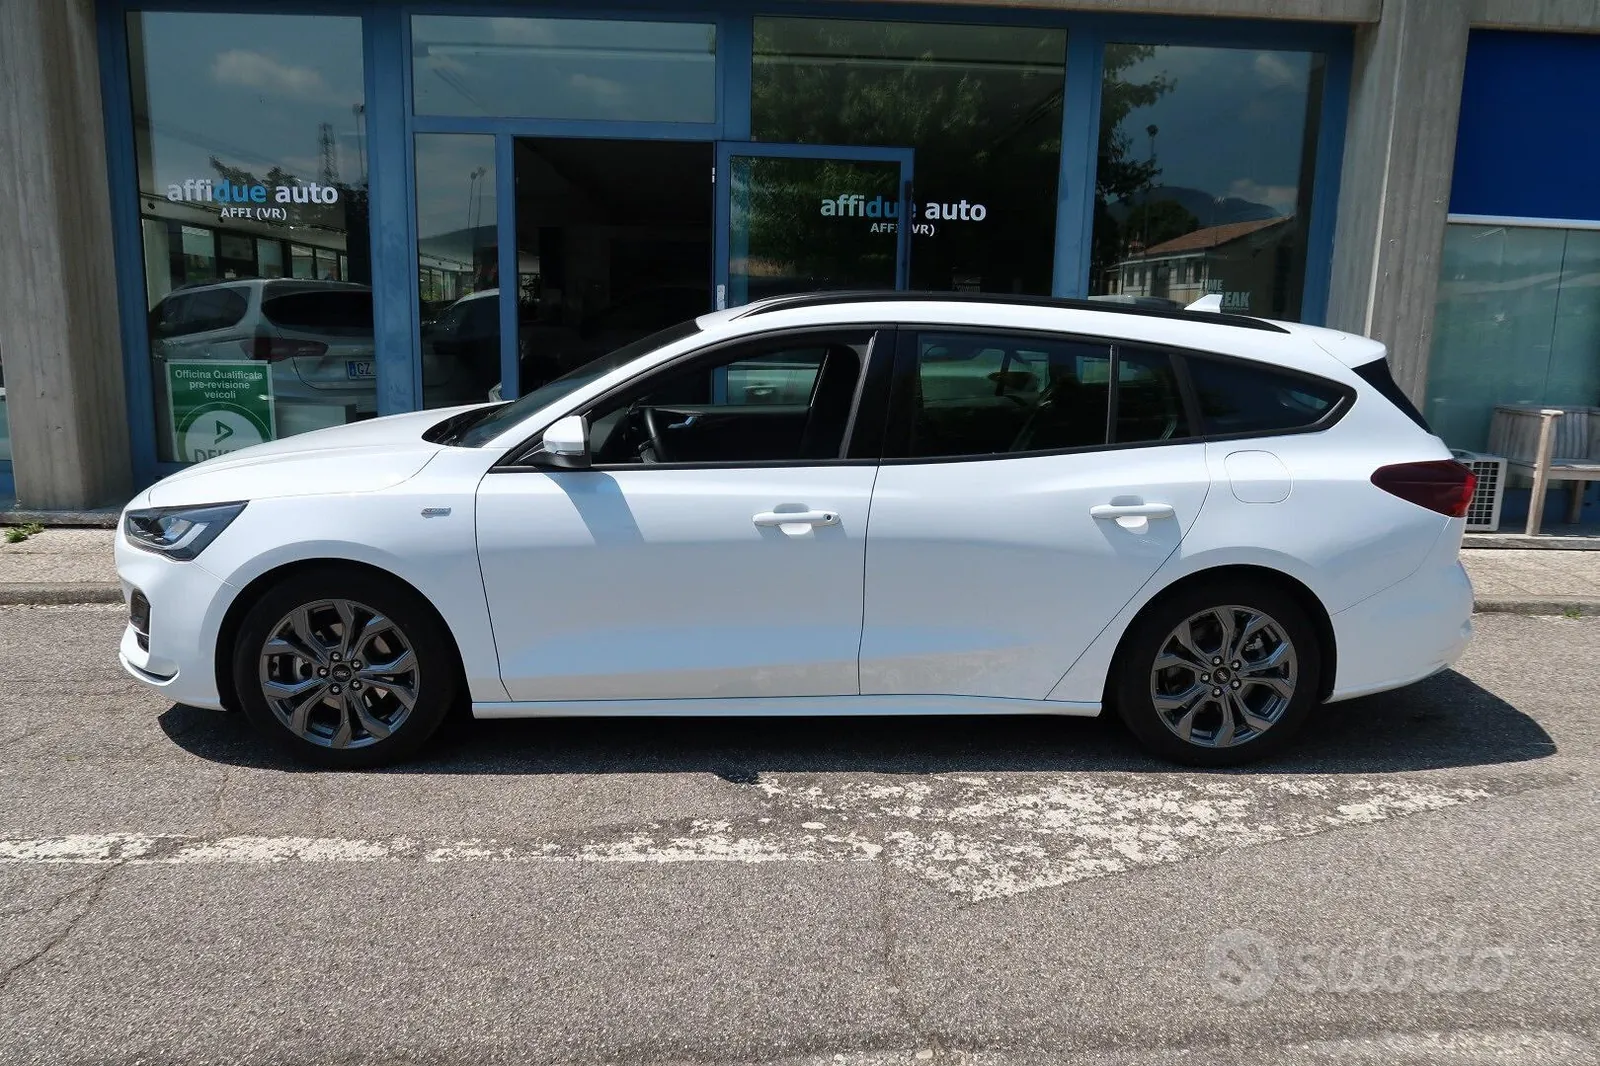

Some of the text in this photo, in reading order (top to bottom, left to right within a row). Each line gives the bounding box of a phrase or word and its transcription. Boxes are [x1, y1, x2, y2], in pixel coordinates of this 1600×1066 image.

[166, 177, 339, 204] affidue auto
[220, 207, 287, 221] AFFI (VR)
[820, 194, 987, 221] affidu auto
[911, 224, 935, 237] VR)
[1209, 291, 1251, 307] EAK
[175, 369, 263, 381] Officina Qualificata
[189, 380, 251, 390] pre-revisione
[204, 390, 237, 399] veicoli
